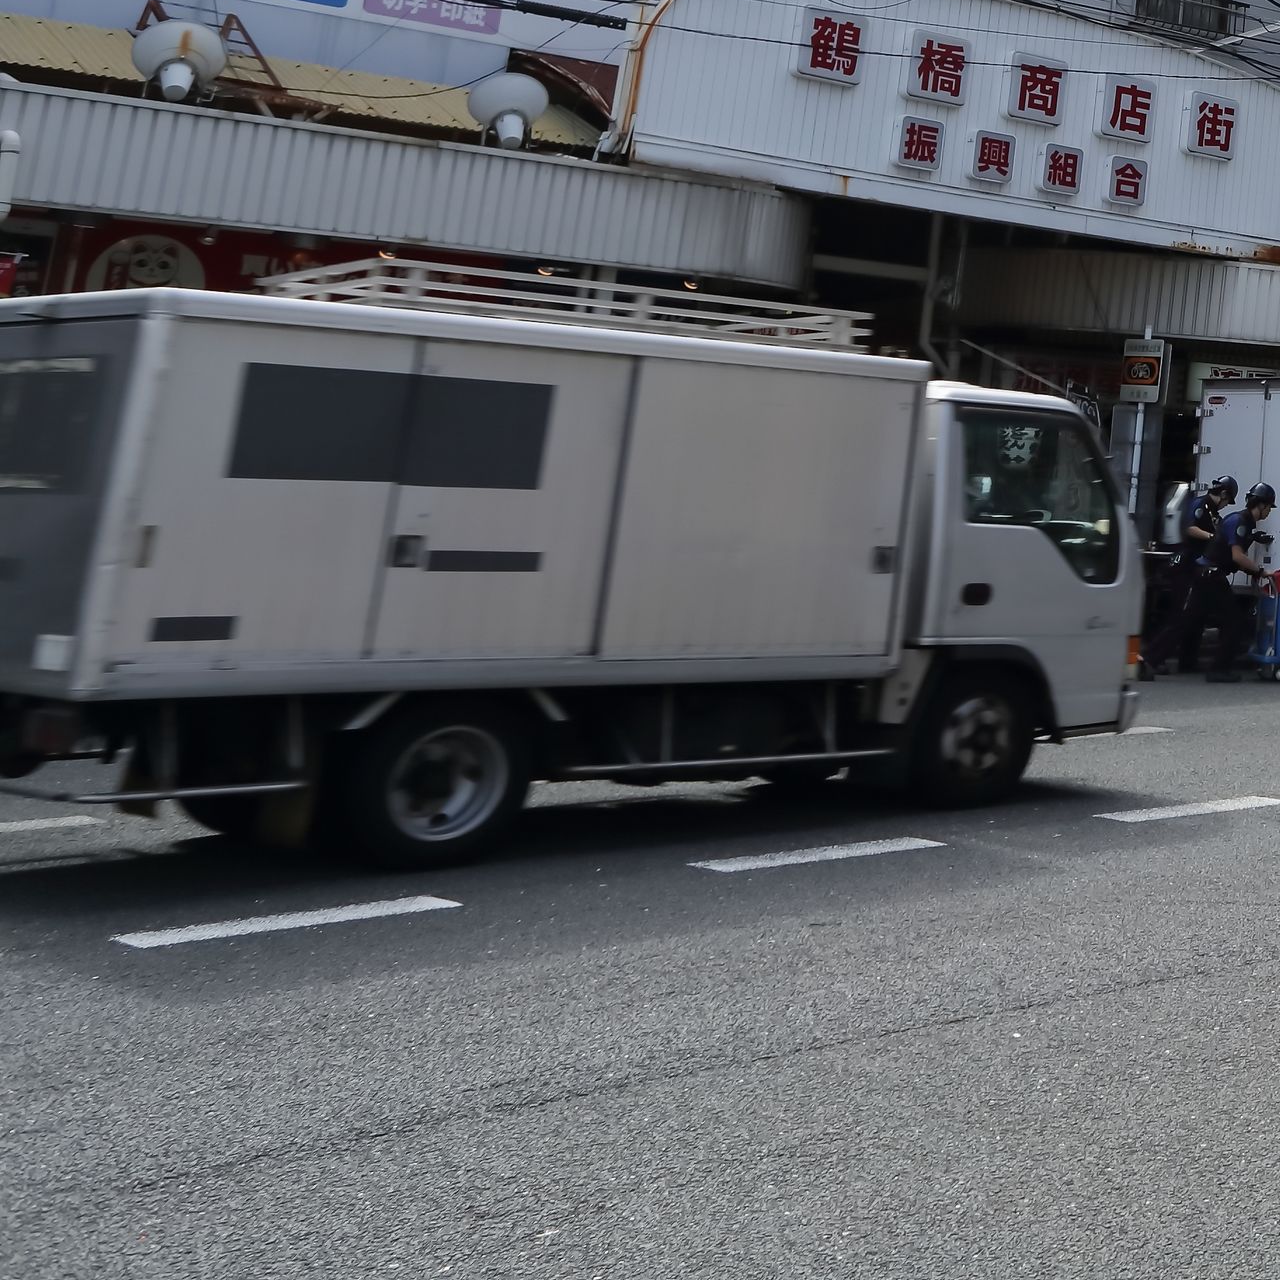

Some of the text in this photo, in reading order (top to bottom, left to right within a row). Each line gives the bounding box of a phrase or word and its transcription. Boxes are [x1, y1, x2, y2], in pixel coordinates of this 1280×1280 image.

[810, 15, 1235, 153] 鶴橋商店街
[902, 121, 1145, 200] 振興組合
